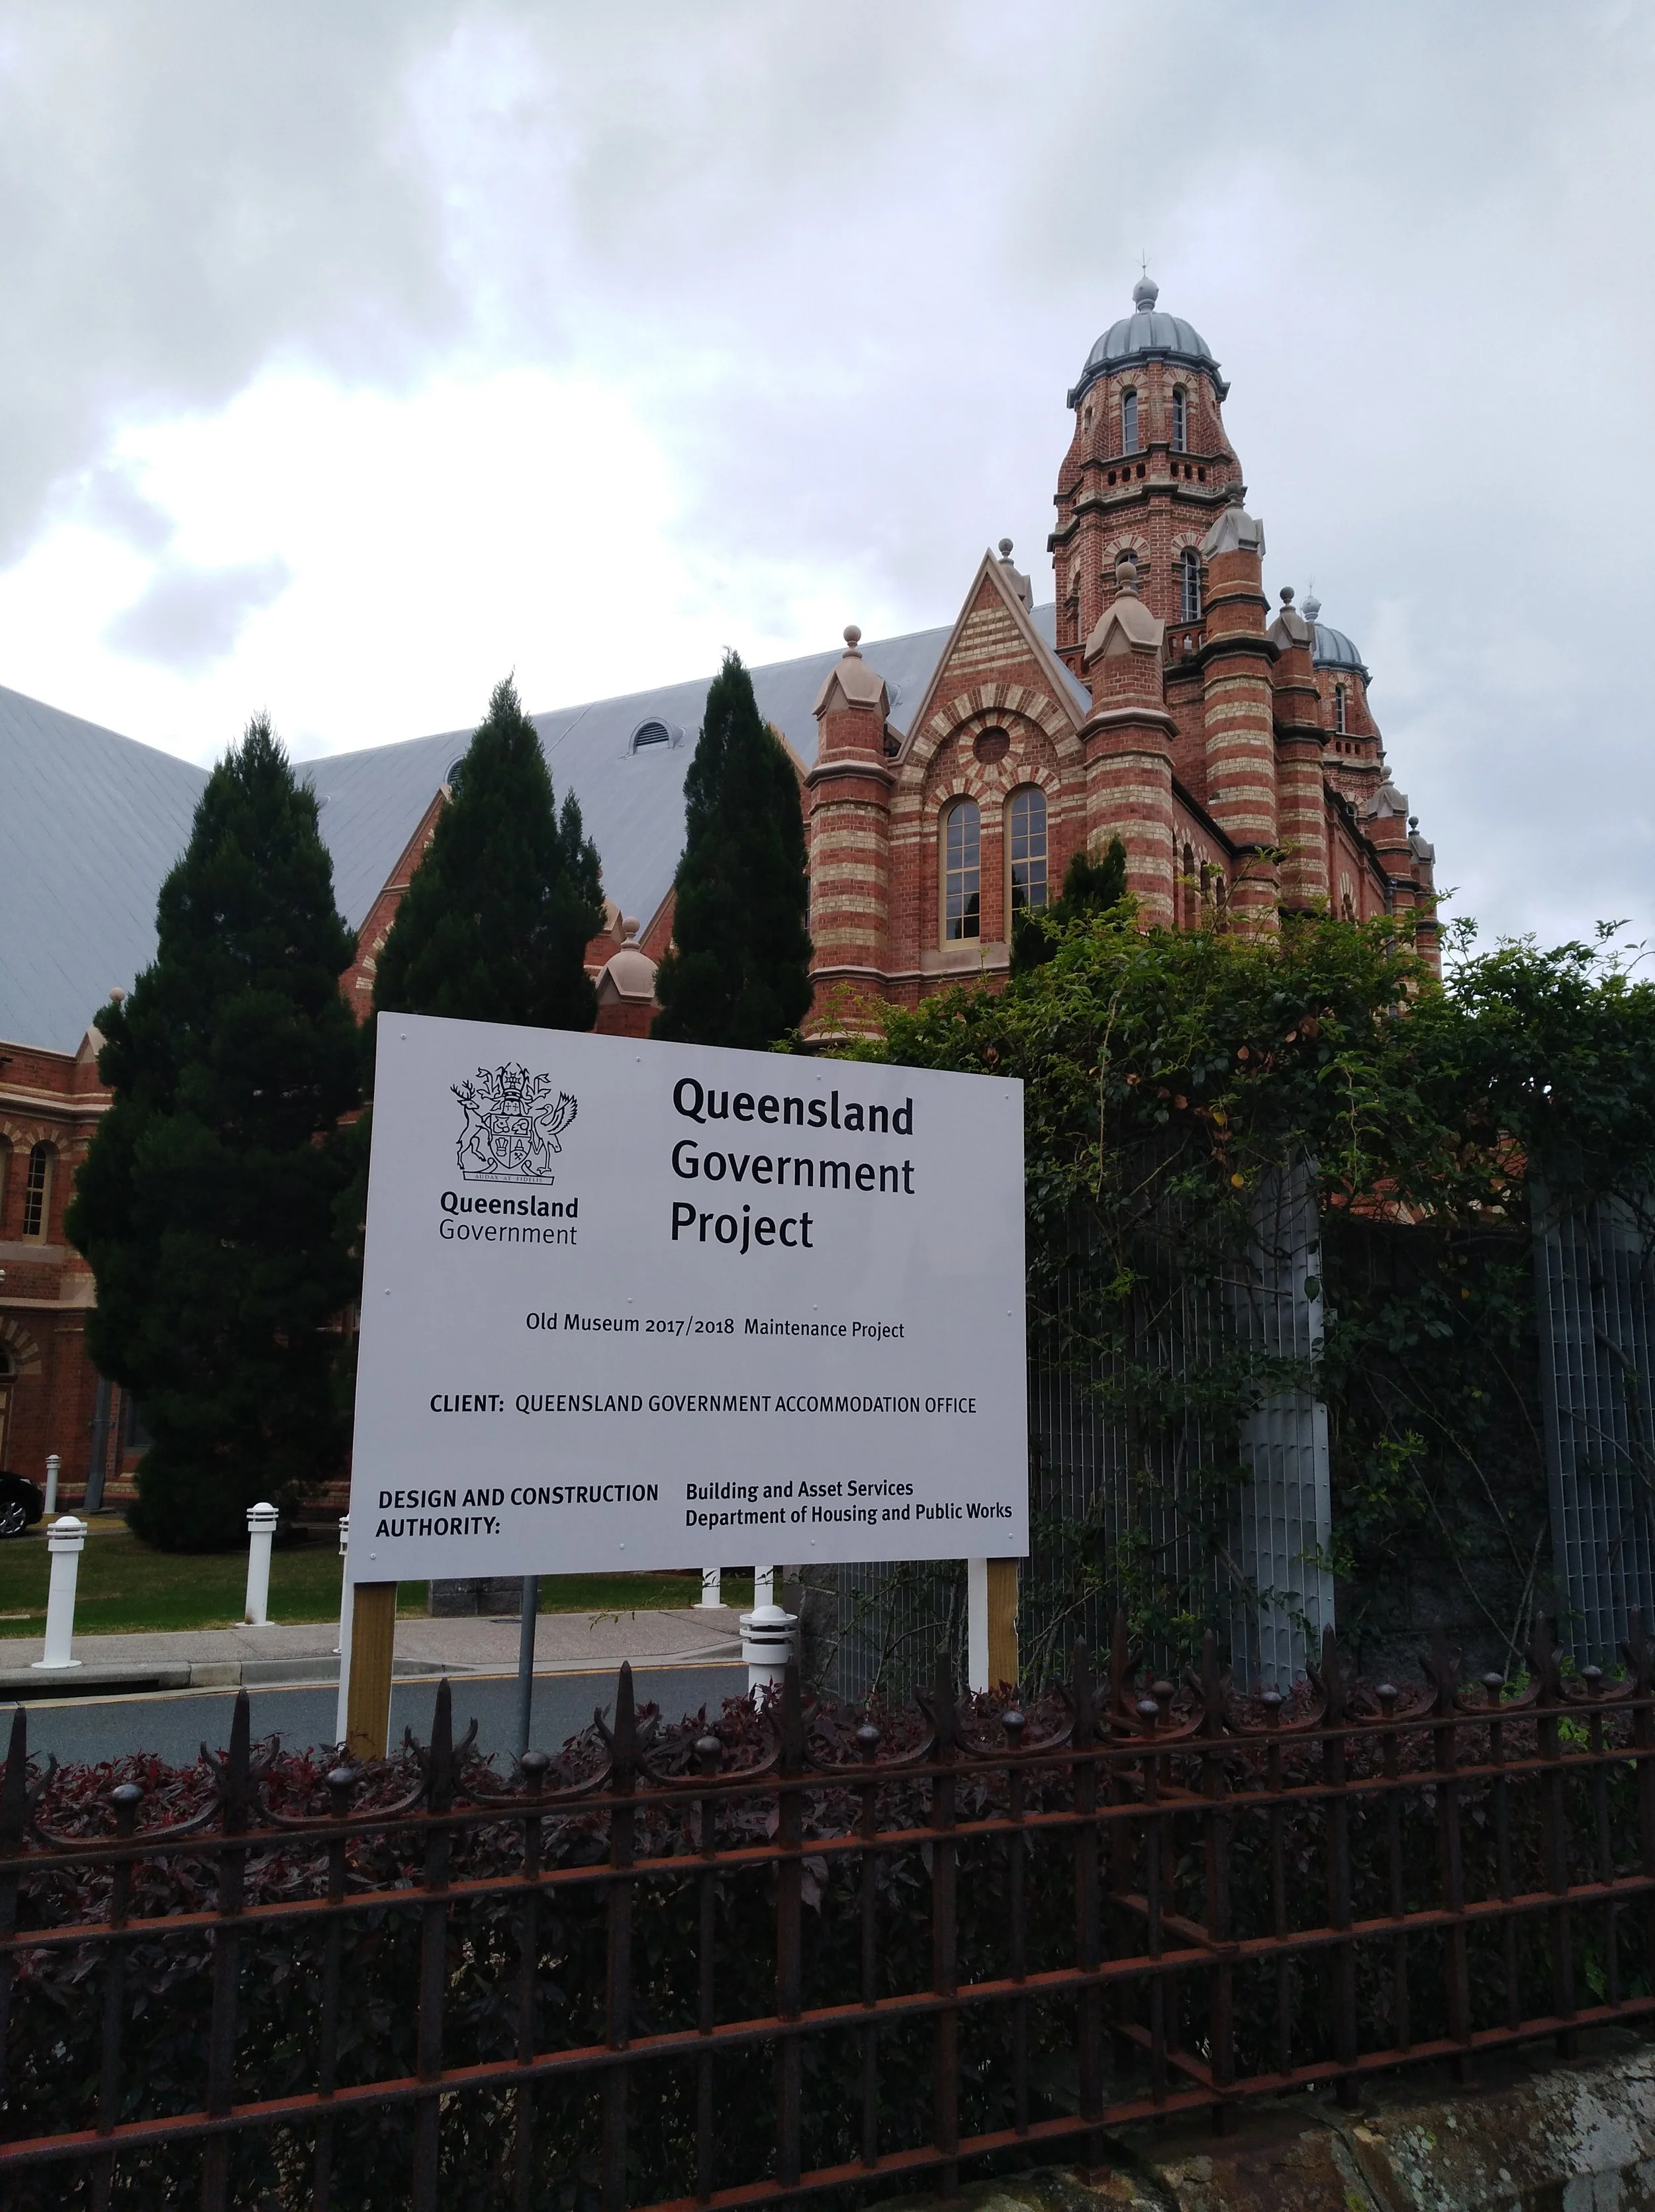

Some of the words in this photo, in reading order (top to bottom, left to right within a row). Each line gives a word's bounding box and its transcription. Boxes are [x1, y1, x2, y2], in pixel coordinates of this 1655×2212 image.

[673, 1078, 913, 1135] Queensland
[672, 1140, 915, 1194] Government
[441, 1191, 578, 1218] Queensland
[440, 1219, 577, 1244] Government
[672, 1202, 814, 1255] Project
[526, 1313, 557, 1330] Old
[564, 1314, 639, 1331] Museum
[645, 1316, 734, 1336] 2017/2018
[745, 1318, 847, 1336] Maintenance
[853, 1322, 904, 1341] Project
[430, 1395, 504, 1412] CLIENT:
[516, 1395, 642, 1414] QUEENSLAND
[649, 1395, 771, 1411] GOVERNMENT
[775, 1396, 920, 1412] ACCOMMODATION
[925, 1397, 976, 1413] OFFICE
[379, 1490, 456, 1508] DESIGN
[462, 1489, 504, 1506] AND
[511, 1485, 657, 1505] CONSTRUCTION
[686, 1482, 759, 1502] Building
[763, 1481, 792, 1498] and
[798, 1481, 843, 1497] Asset
[847, 1479, 913, 1497] Services
[375, 1516, 500, 1537] AUTHORITY:
[686, 1508, 786, 1530] Department
[791, 1506, 808, 1522] of
[812, 1504, 878, 1525] Housing
[882, 1504, 910, 1521] and
[916, 1503, 962, 1519] Public
[967, 1502, 1012, 1518] Works
